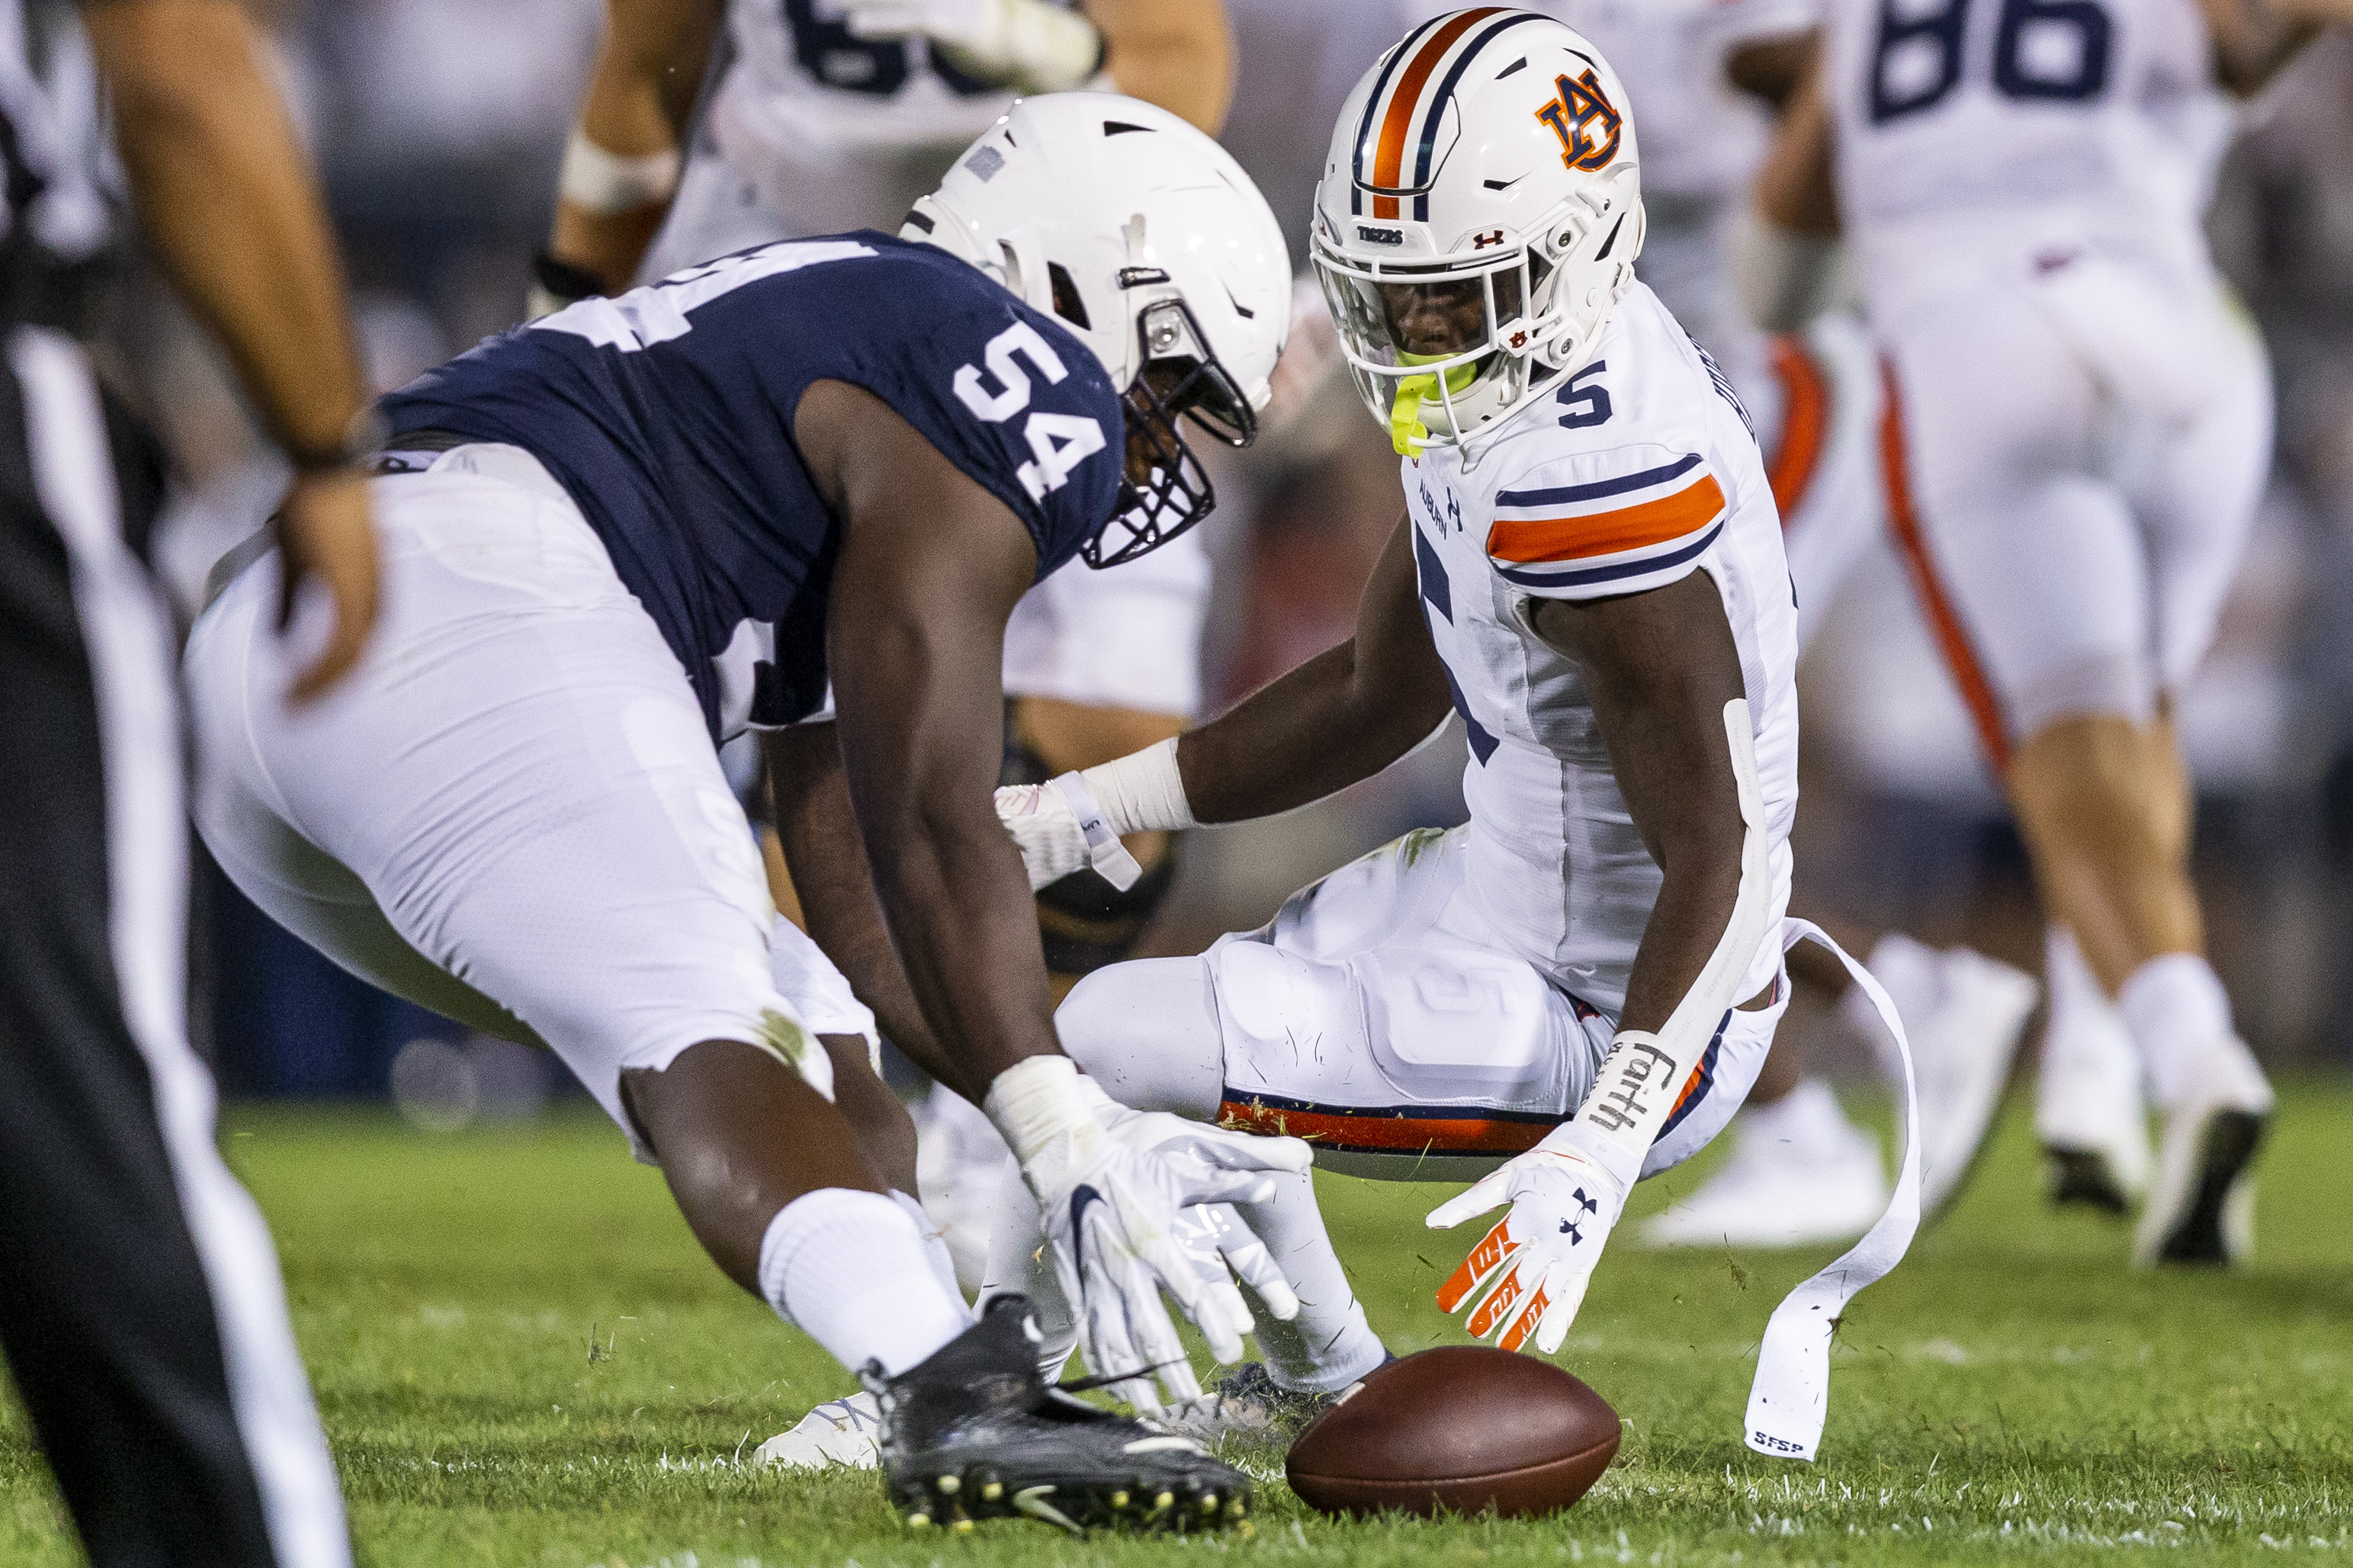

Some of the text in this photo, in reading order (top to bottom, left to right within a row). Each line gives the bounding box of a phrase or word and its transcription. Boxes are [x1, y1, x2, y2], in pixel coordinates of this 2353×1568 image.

[1356, 225, 1403, 244] TIGERS
[953, 320, 1106, 505] 54
[1556, 359, 1613, 429] 5
[1420, 478, 1447, 540] AUBURN
[1702, 935, 1741, 1000] SUPERSKIN
[1588, 1043, 1677, 1132] Faith
[1754, 1431, 1803, 1453] SFSP
